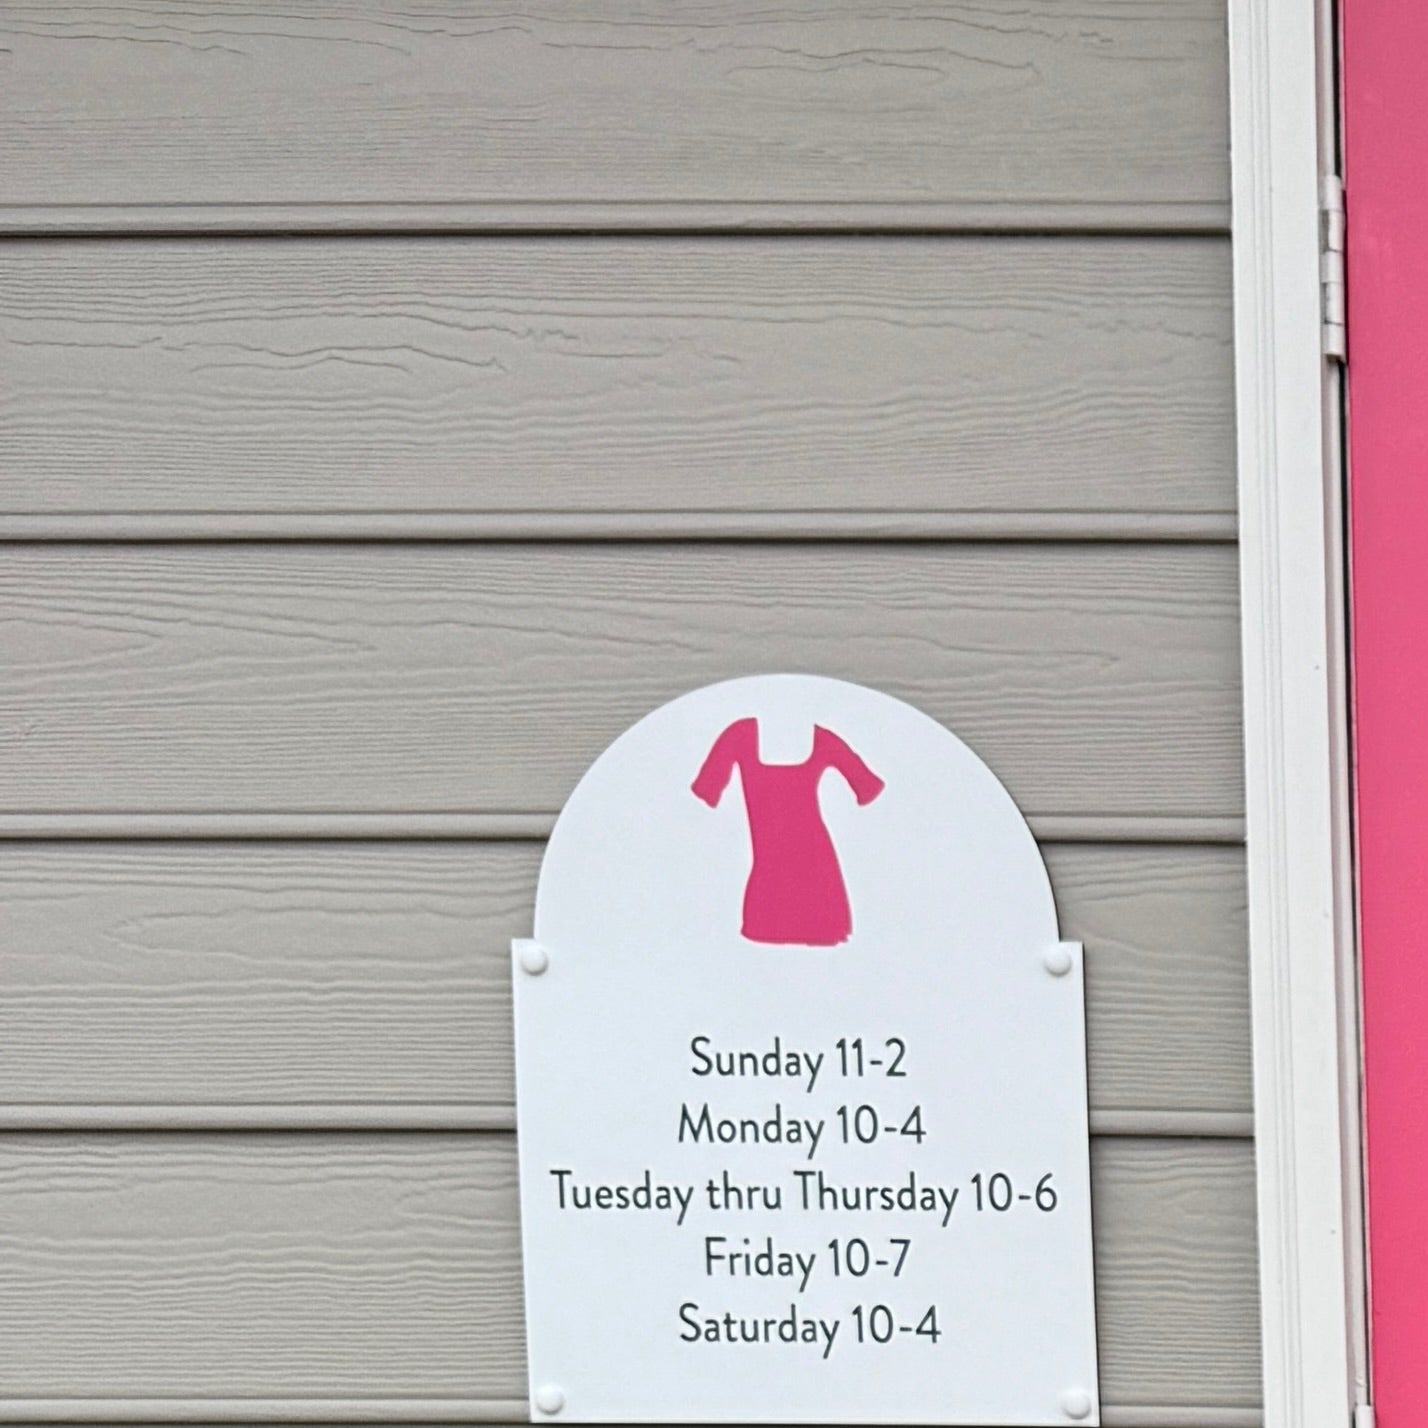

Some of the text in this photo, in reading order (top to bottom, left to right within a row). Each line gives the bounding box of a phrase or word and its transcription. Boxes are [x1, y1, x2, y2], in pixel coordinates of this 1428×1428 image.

[690, 1035, 907, 1094] Sunday 11-2
[678, 1103, 927, 1161] Monday 10-4
[549, 1169, 1058, 1228] Tuesday thru Thursday 10-6
[704, 1236, 911, 1293] Friday 10-7
[678, 1302, 942, 1360] Saturday 10-4
